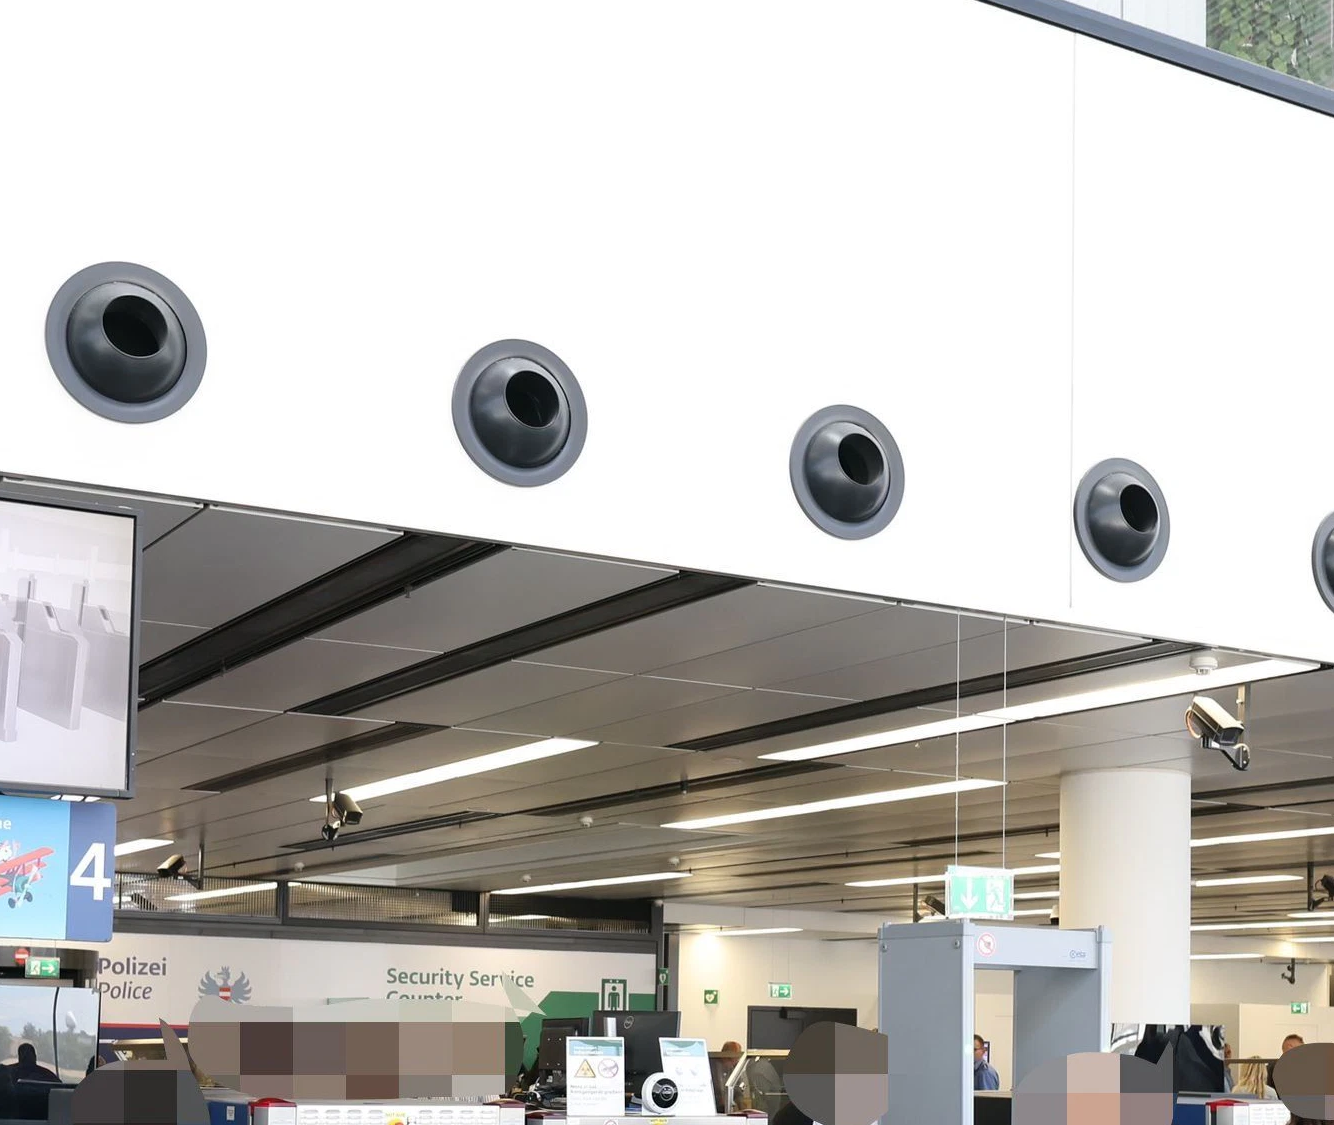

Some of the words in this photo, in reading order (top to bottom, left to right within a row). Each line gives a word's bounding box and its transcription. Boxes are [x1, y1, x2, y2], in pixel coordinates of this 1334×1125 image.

[70, 842, 111, 901] 4
[98, 956, 167, 976] Polizei
[386, 967, 464, 990] Security
[99, 981, 153, 1000] Police
